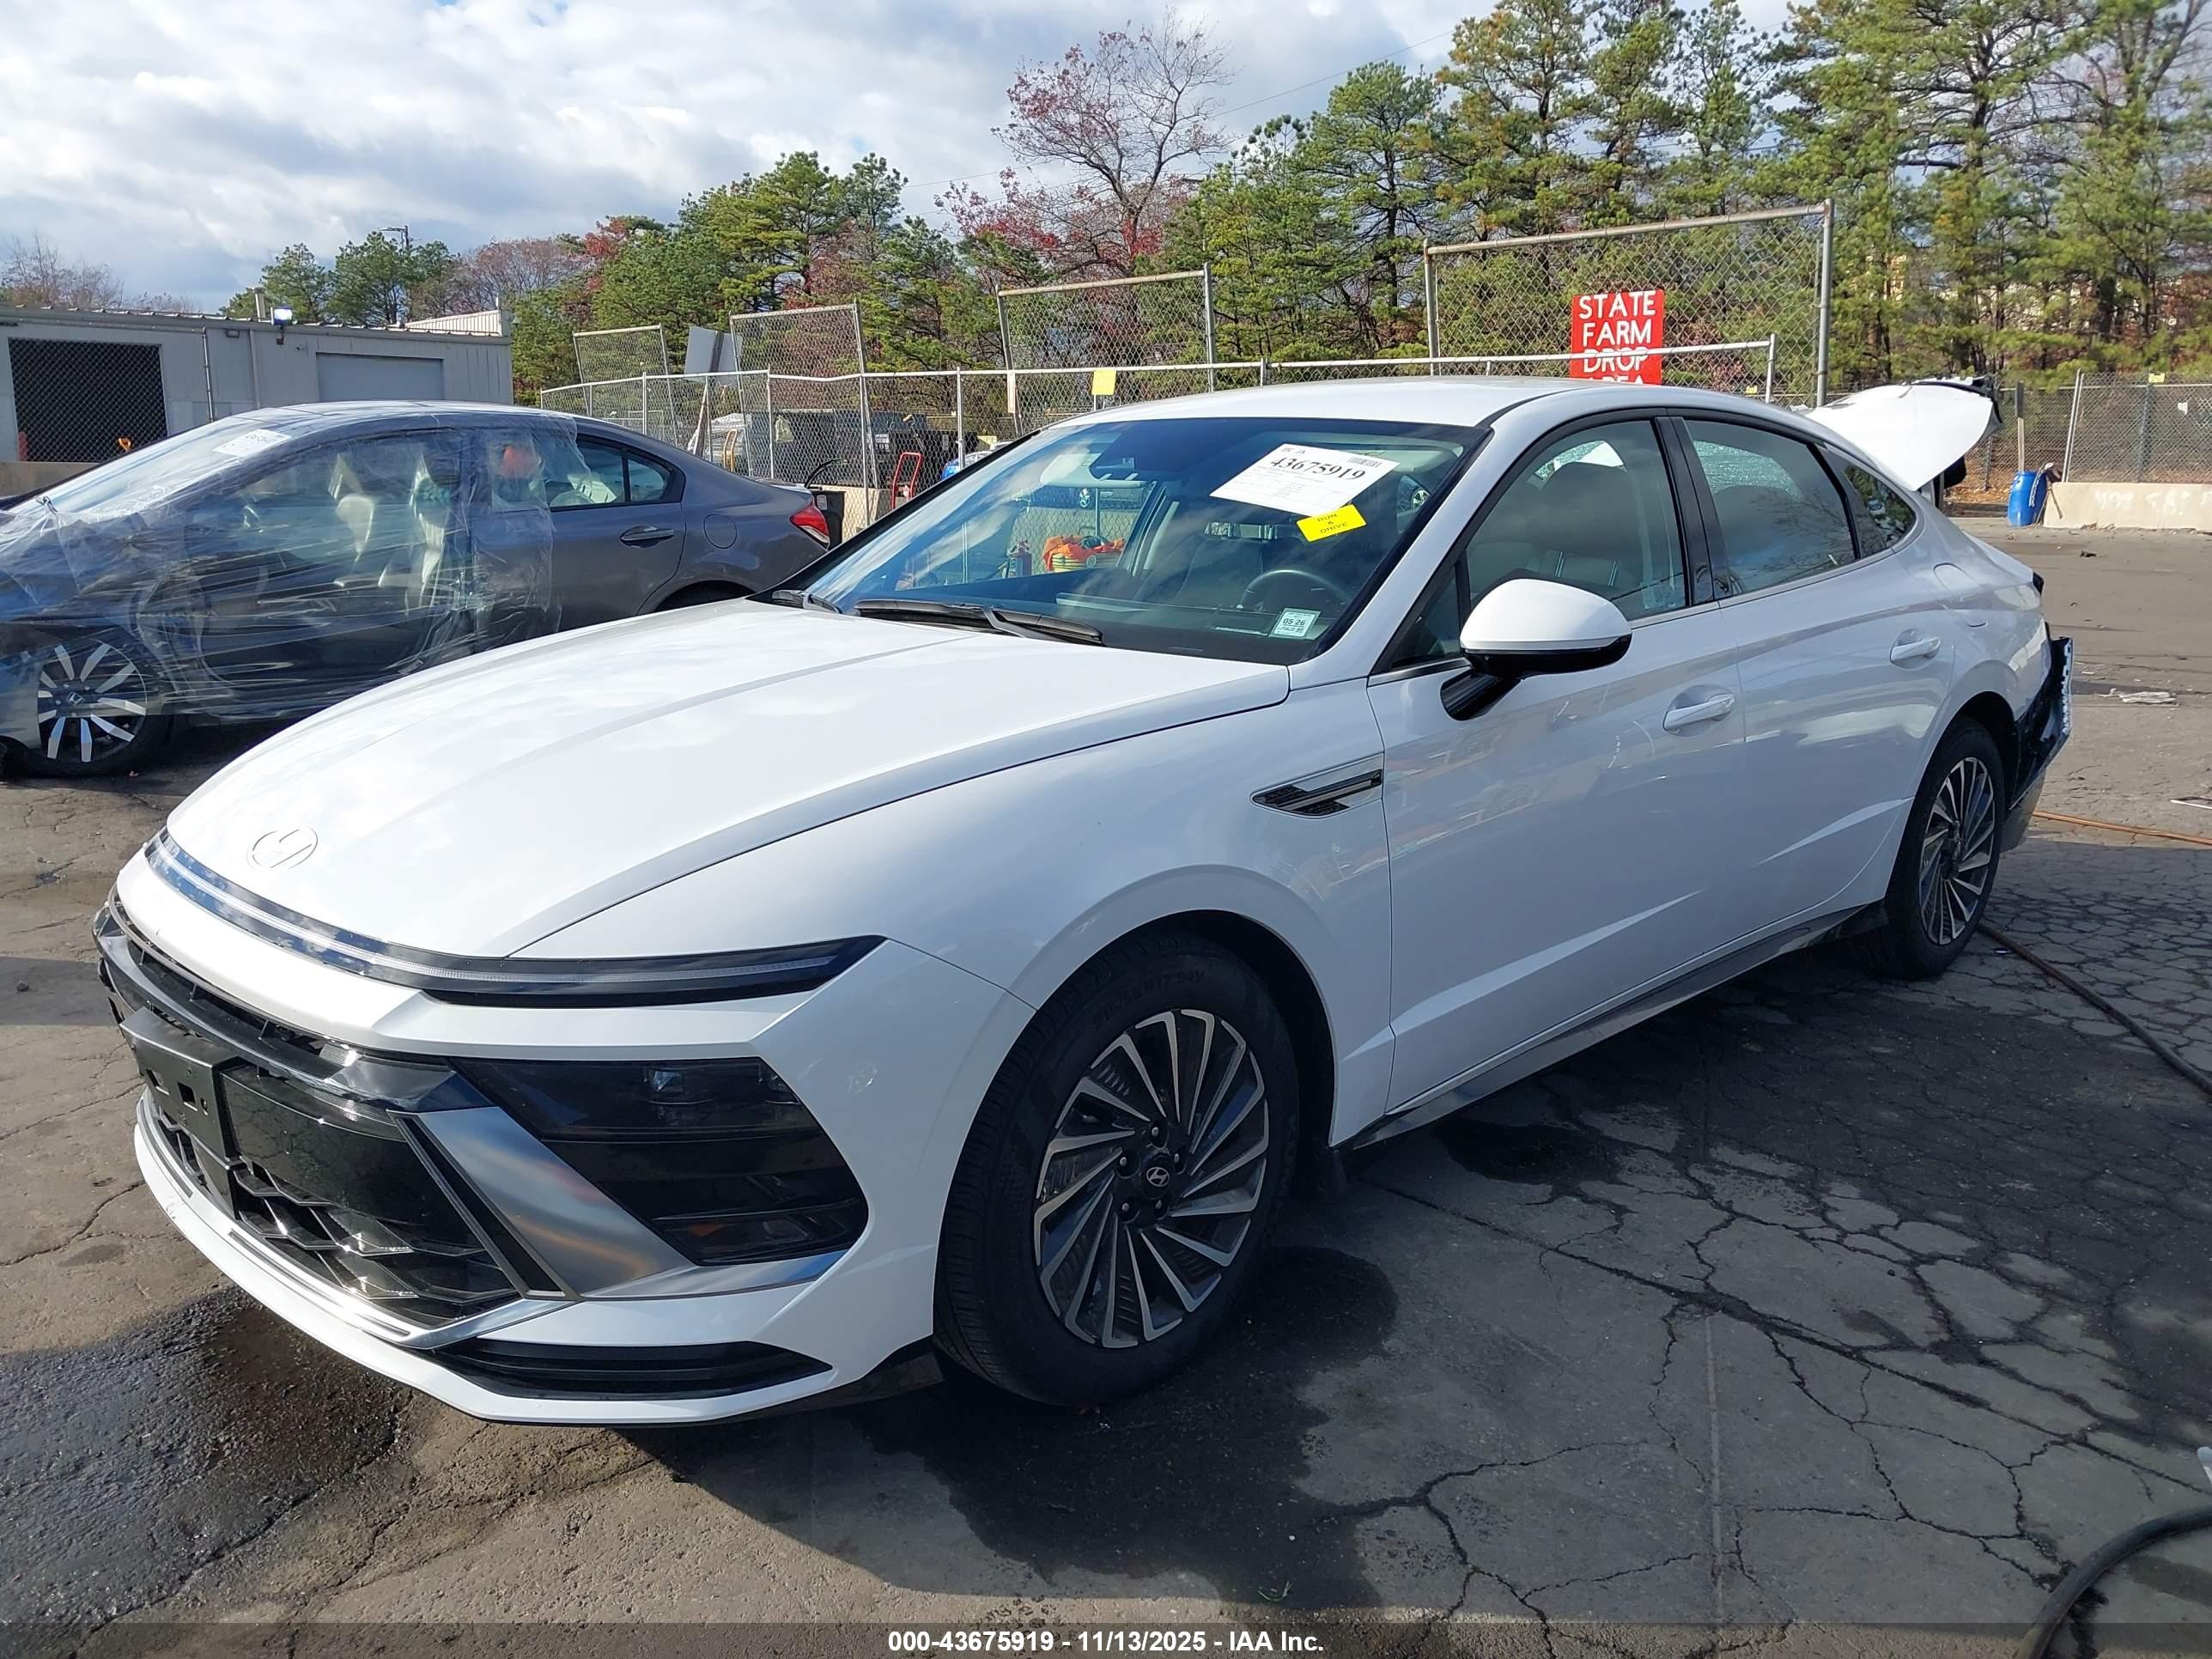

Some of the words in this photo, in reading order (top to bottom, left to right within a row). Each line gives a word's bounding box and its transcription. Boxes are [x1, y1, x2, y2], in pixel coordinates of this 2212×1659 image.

[1579, 290, 1656, 319] STATE
[1583, 319, 1652, 347] FARM
[1583, 346, 1650, 374] DROP
[1271, 457, 1365, 480] 43675919
